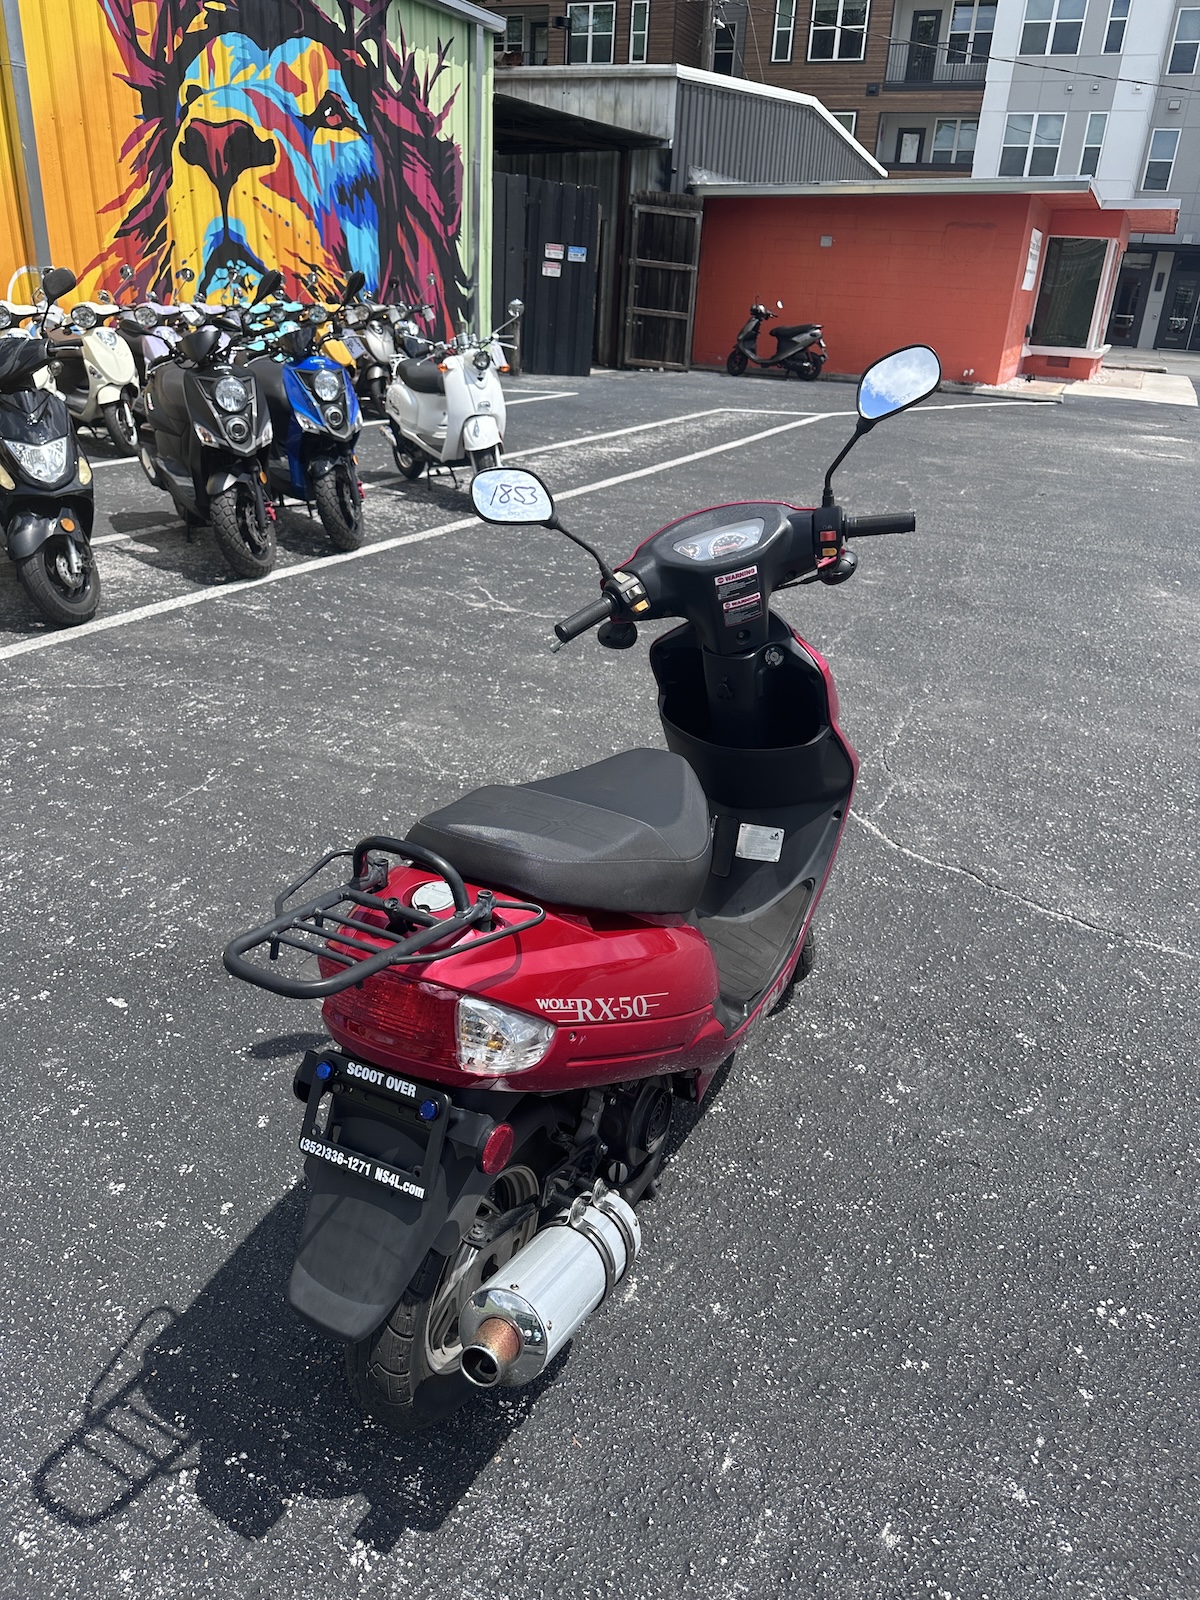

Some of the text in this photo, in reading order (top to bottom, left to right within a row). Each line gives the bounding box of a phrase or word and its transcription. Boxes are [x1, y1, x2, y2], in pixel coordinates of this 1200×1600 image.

[489, 483, 538, 506] 1853
[725, 567, 756, 582] WARNING
[535, 996, 651, 1022] WOLF RX-50
[346, 1061, 417, 1098] SCOOT OVER
[300, 1137, 425, 1199] (352)336-1271 NS4L.com
